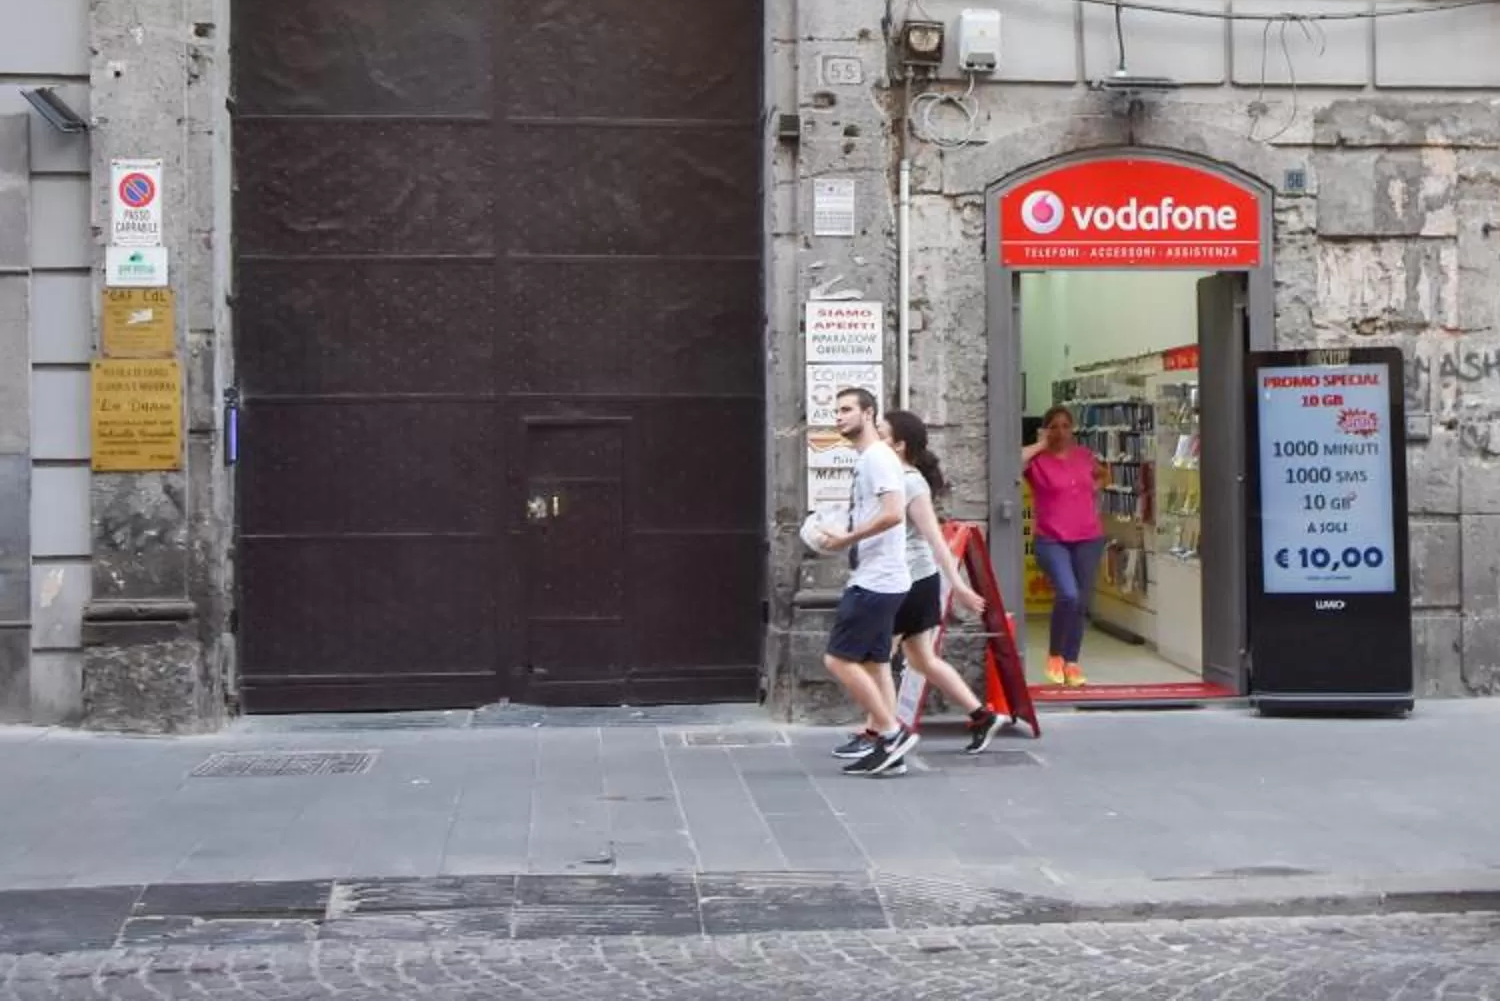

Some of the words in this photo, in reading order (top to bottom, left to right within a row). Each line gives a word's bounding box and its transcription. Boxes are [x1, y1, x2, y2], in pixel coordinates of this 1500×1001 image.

[829, 62, 857, 80] 55
[1071, 197, 1238, 231] vodafone
[1024, 246, 1080, 257] TELEFONI
[1089, 246, 1156, 257] ACCESSORI
[1166, 246, 1238, 257] ASSISTENZA
[817, 308, 873, 317] SIAMO
[813, 322, 876, 330] APERTI
[1263, 375, 1320, 388] PROMO
[1323, 374, 1380, 386] SPECIAL
[1301, 394, 1319, 407] 10
[1322, 394, 1344, 406] GB
[1273, 440, 1319, 457] 1000
[1323, 442, 1379, 456] MINUTI
[1286, 467, 1331, 484] 1000
[1335, 470, 1368, 483] SMS
[1303, 494, 1326, 510] 10
[1330, 498, 1351, 510] GB
[1307, 522, 1317, 534] A
[1320, 522, 1348, 534] SOLI
[1274, 547, 1289, 569] €
[1298, 546, 1384, 572] 10,00
